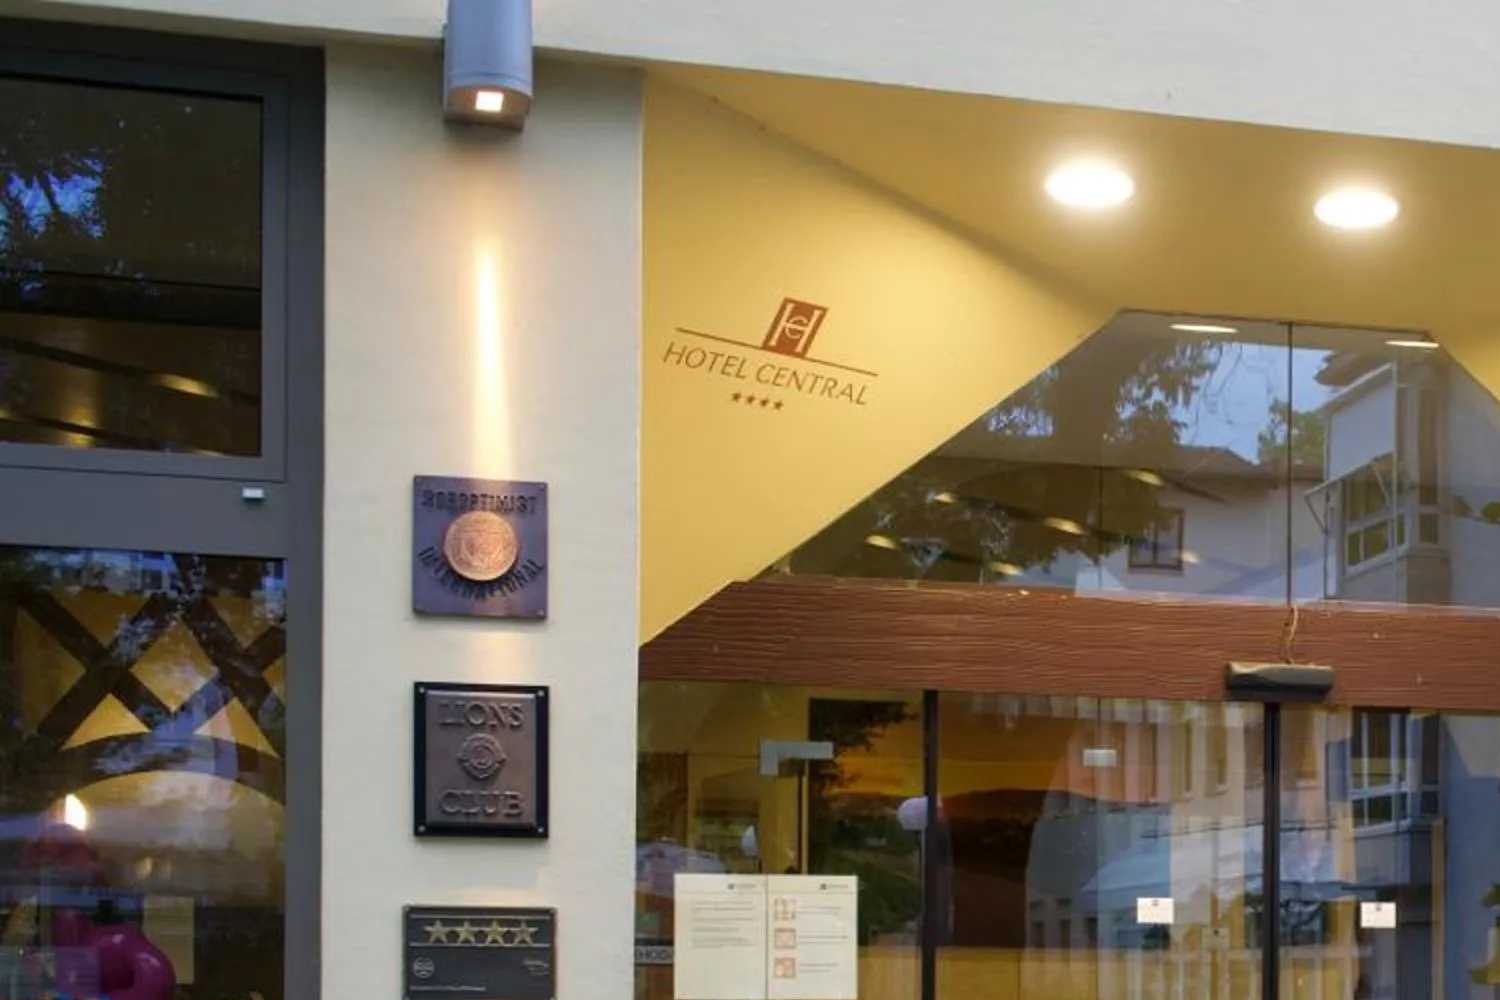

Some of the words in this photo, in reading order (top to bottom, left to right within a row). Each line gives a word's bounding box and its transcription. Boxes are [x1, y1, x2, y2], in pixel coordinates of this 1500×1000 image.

[662, 341, 747, 379] HOTEL
[755, 363, 868, 406] CENTRAL
[438, 701, 525, 729] LIONS
[441, 789, 525, 817] CLUB
